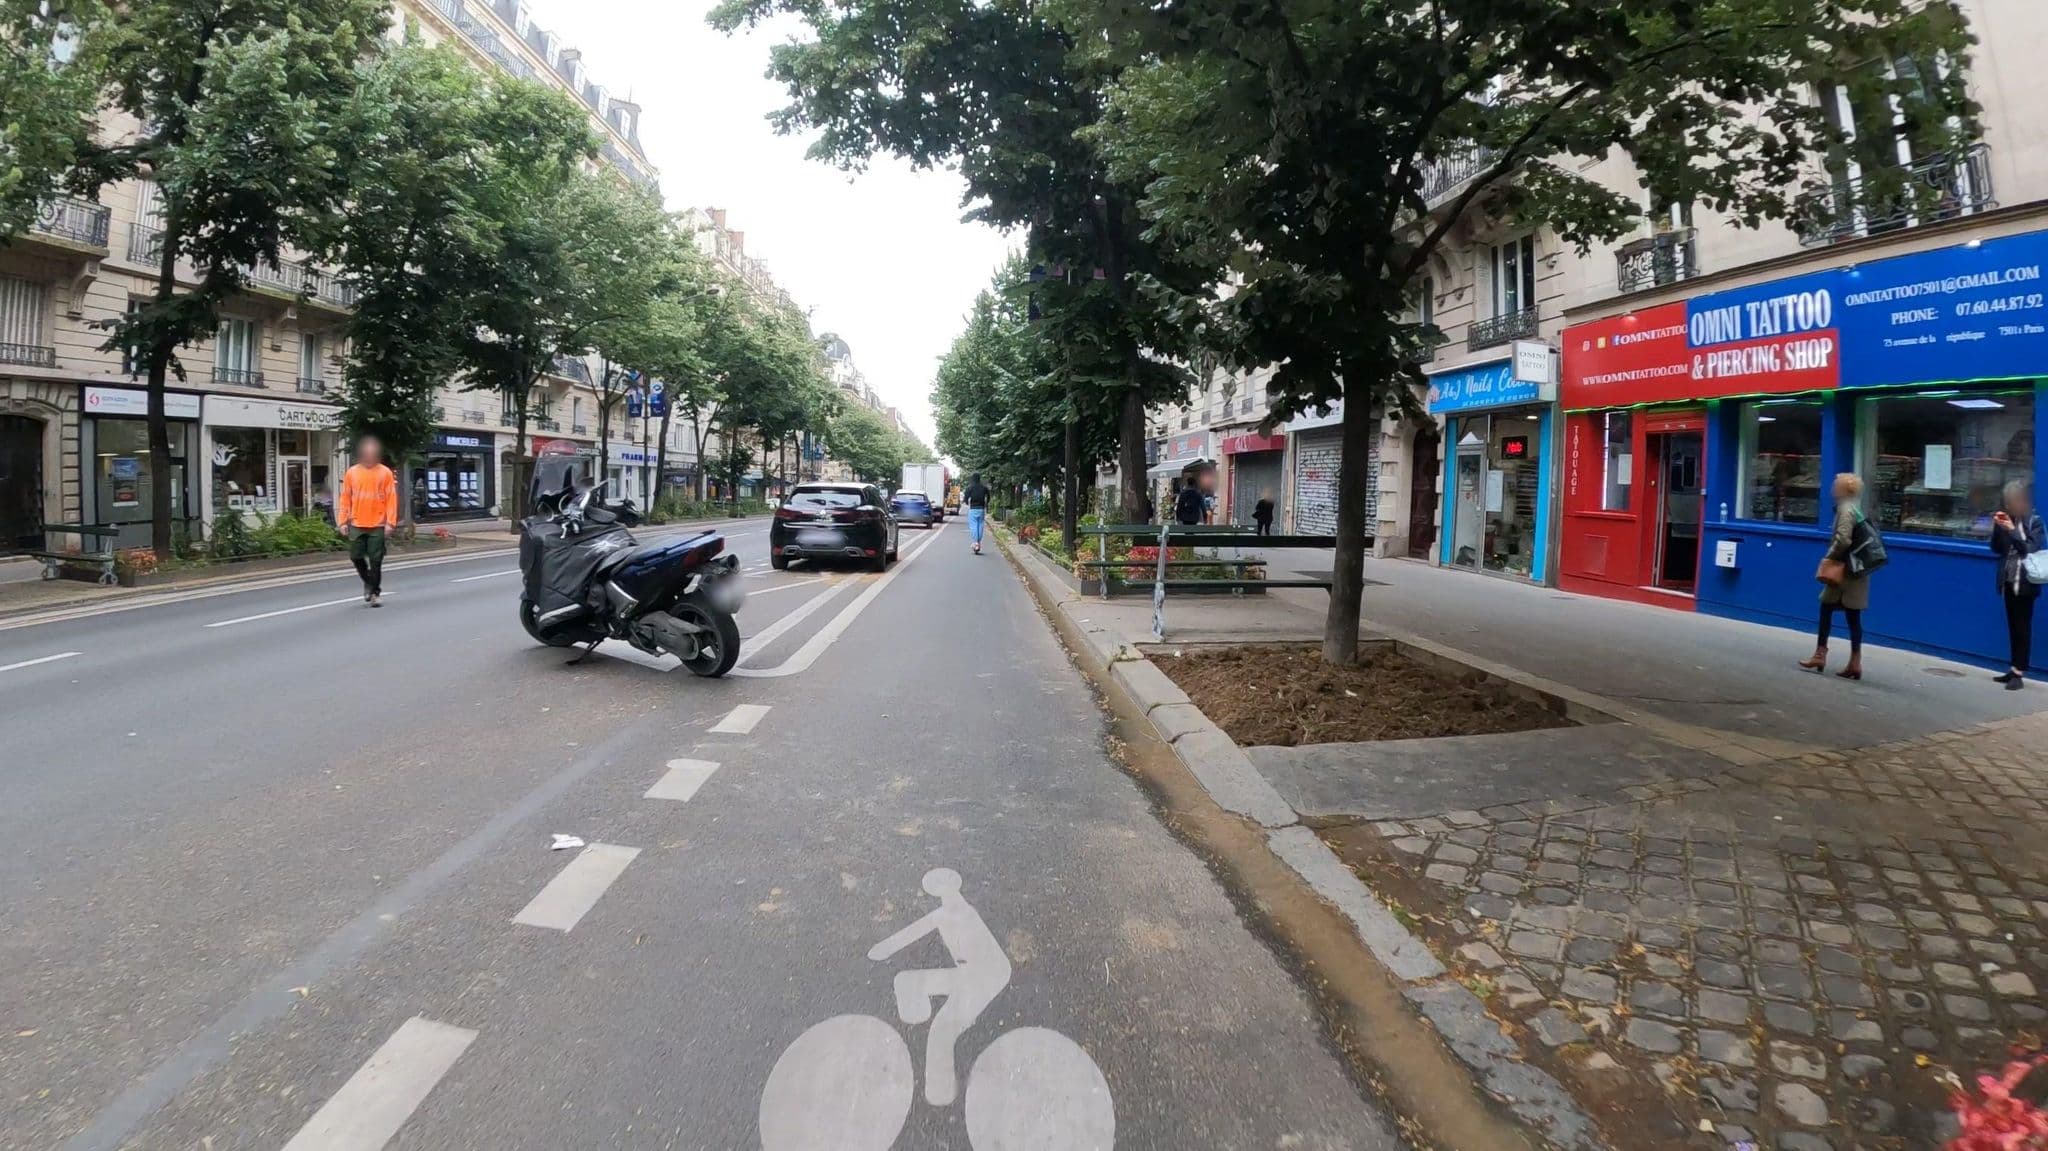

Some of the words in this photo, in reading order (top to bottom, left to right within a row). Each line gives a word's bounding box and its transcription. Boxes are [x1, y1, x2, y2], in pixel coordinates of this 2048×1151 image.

[1690, 305, 1742, 346] OMNI
[1746, 288, 1832, 338] TATTOO
[1891, 307, 1939, 325] PHONE:
[1956, 294, 2044, 317] 07.60.44.87.92
[1620, 324, 1688, 345] OMNITATTOO
[1691, 354, 1704, 380] &
[1707, 343, 1780, 379] PIERCING
[1784, 337, 1833, 371] SHOP
[1465, 372, 1492, 398] Nails
[1582, 364, 1688, 386] WWW.OMNITATTOO.COM
[621, 452, 658, 463] PHARMCIE
[1571, 425, 1580, 496] TATOUAGE
